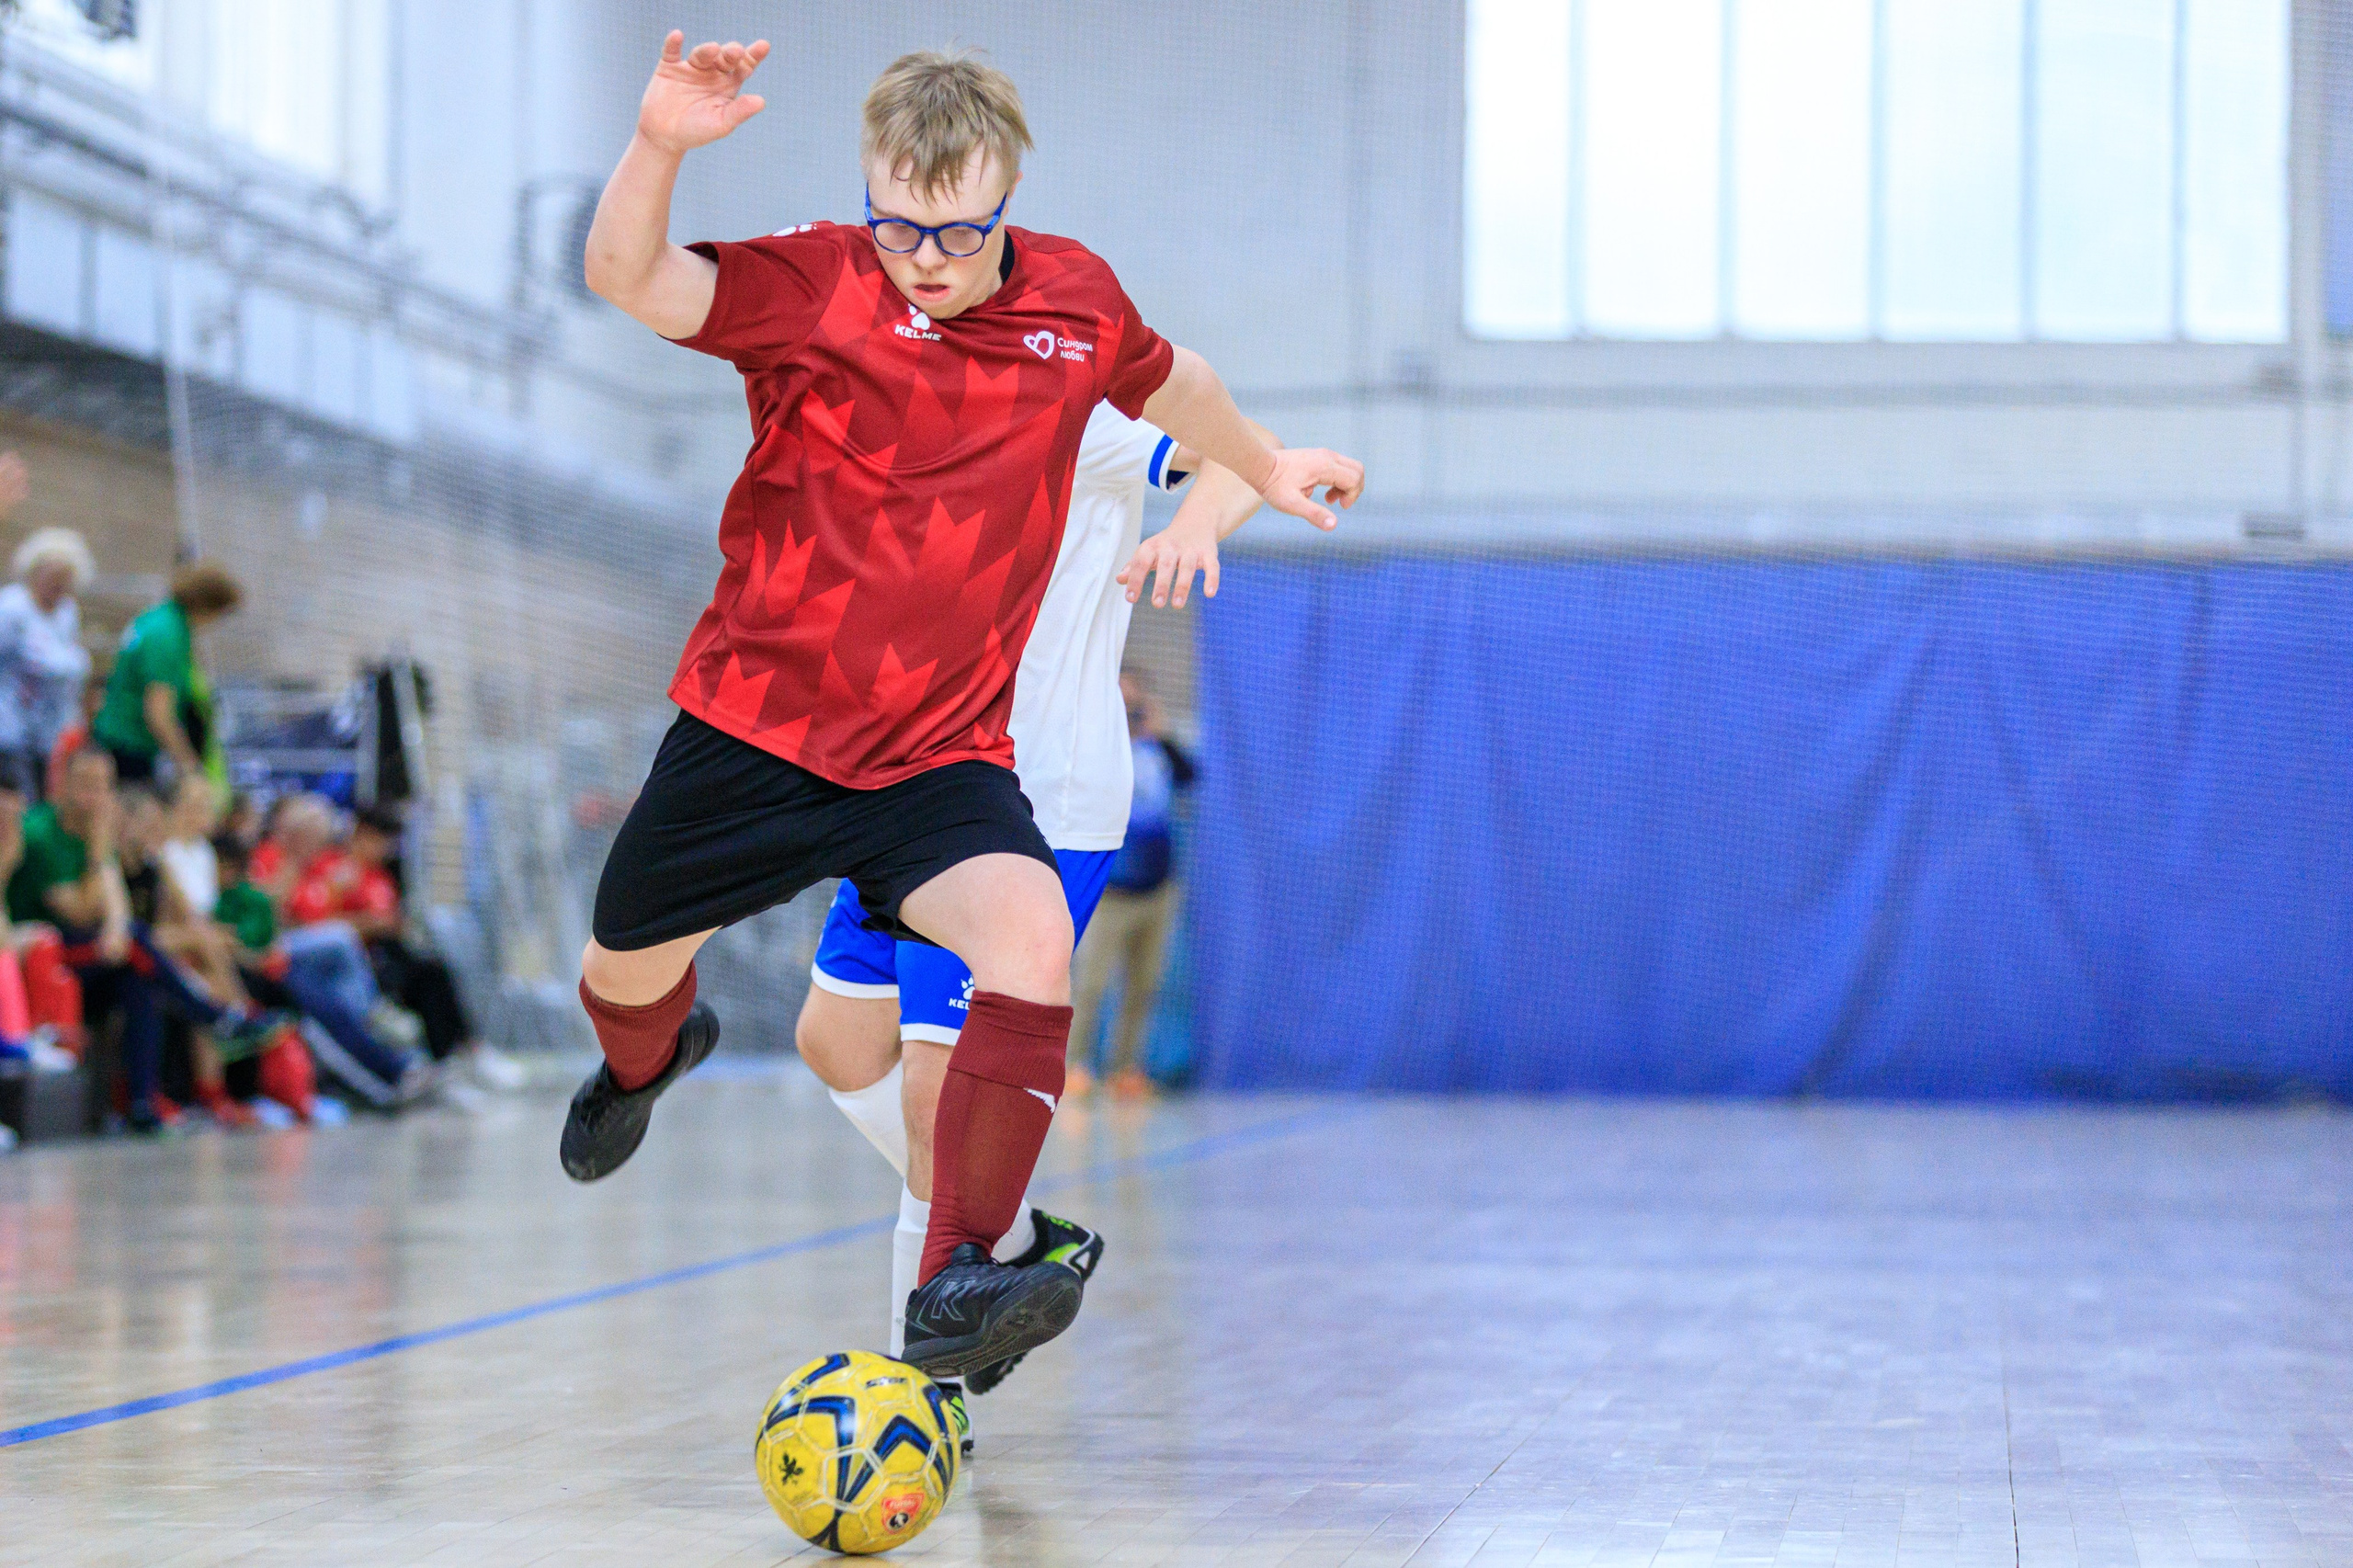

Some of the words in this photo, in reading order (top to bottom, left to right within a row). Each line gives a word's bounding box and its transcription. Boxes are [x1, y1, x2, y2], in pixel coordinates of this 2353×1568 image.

[894, 324, 942, 341] KELME
[1057, 337, 1093, 352] Синдром
[949, 997, 971, 1010] KEL
